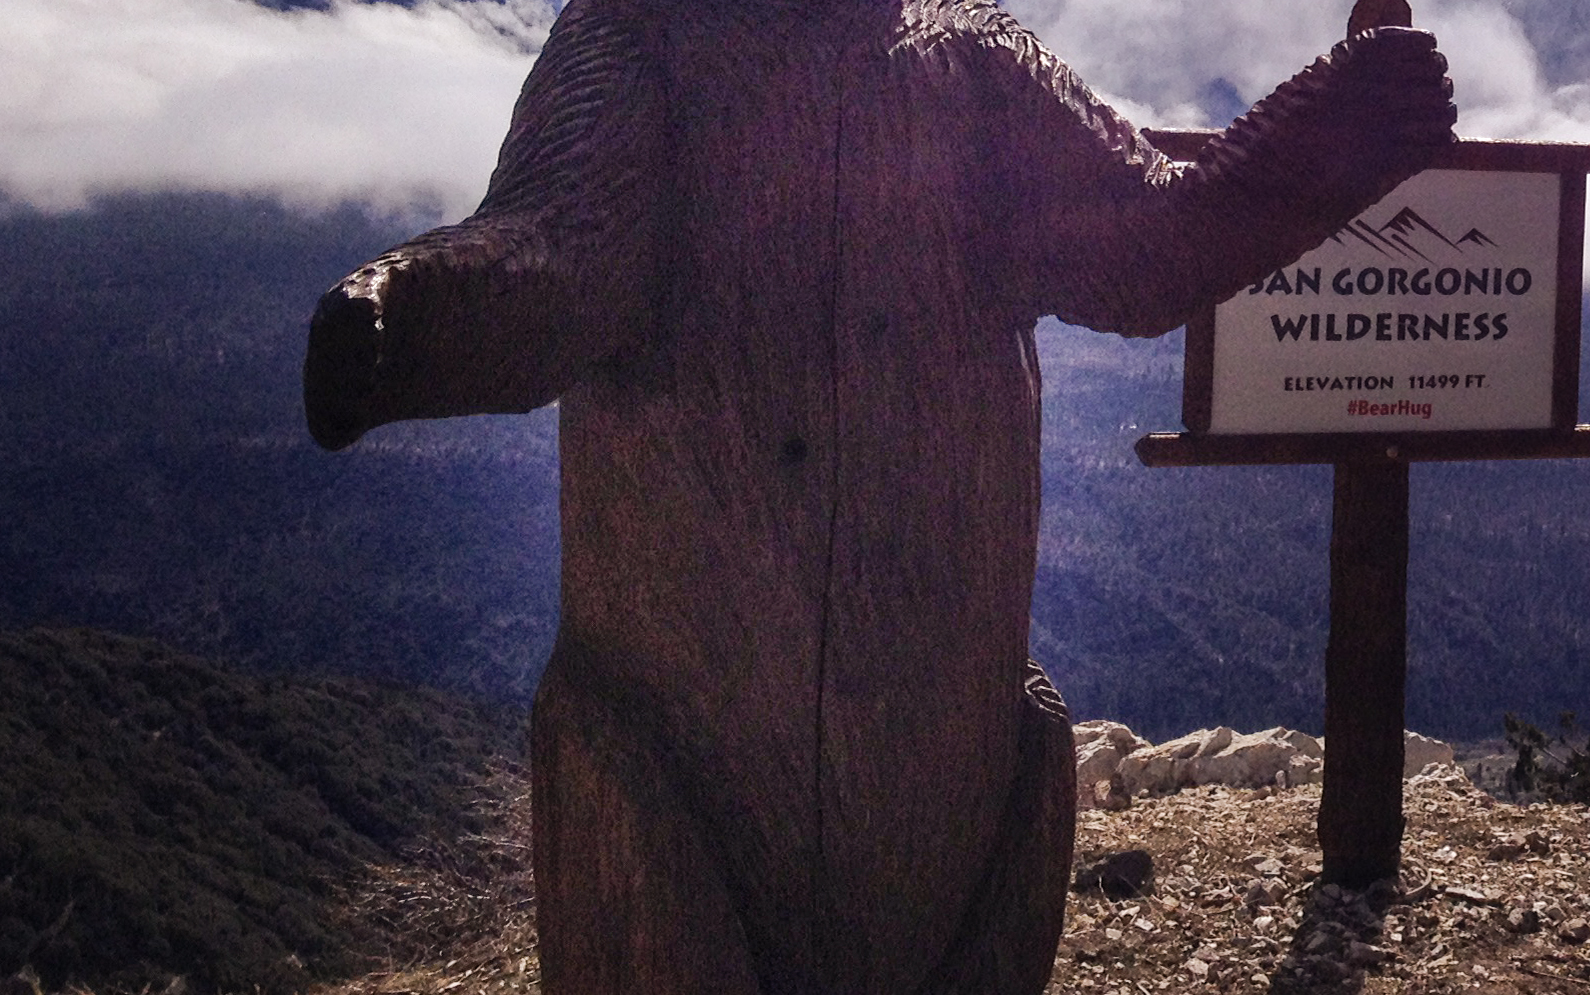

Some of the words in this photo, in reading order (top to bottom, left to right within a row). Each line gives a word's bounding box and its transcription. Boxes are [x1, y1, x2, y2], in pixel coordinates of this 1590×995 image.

[1332, 267, 1532, 295] GORGONIO
[1270, 313, 1509, 342] WILDERNESS
[1284, 376, 1395, 391] ELEVATION
[1408, 375, 1460, 390] 11499
[1347, 400, 1432, 419] #BearHug
